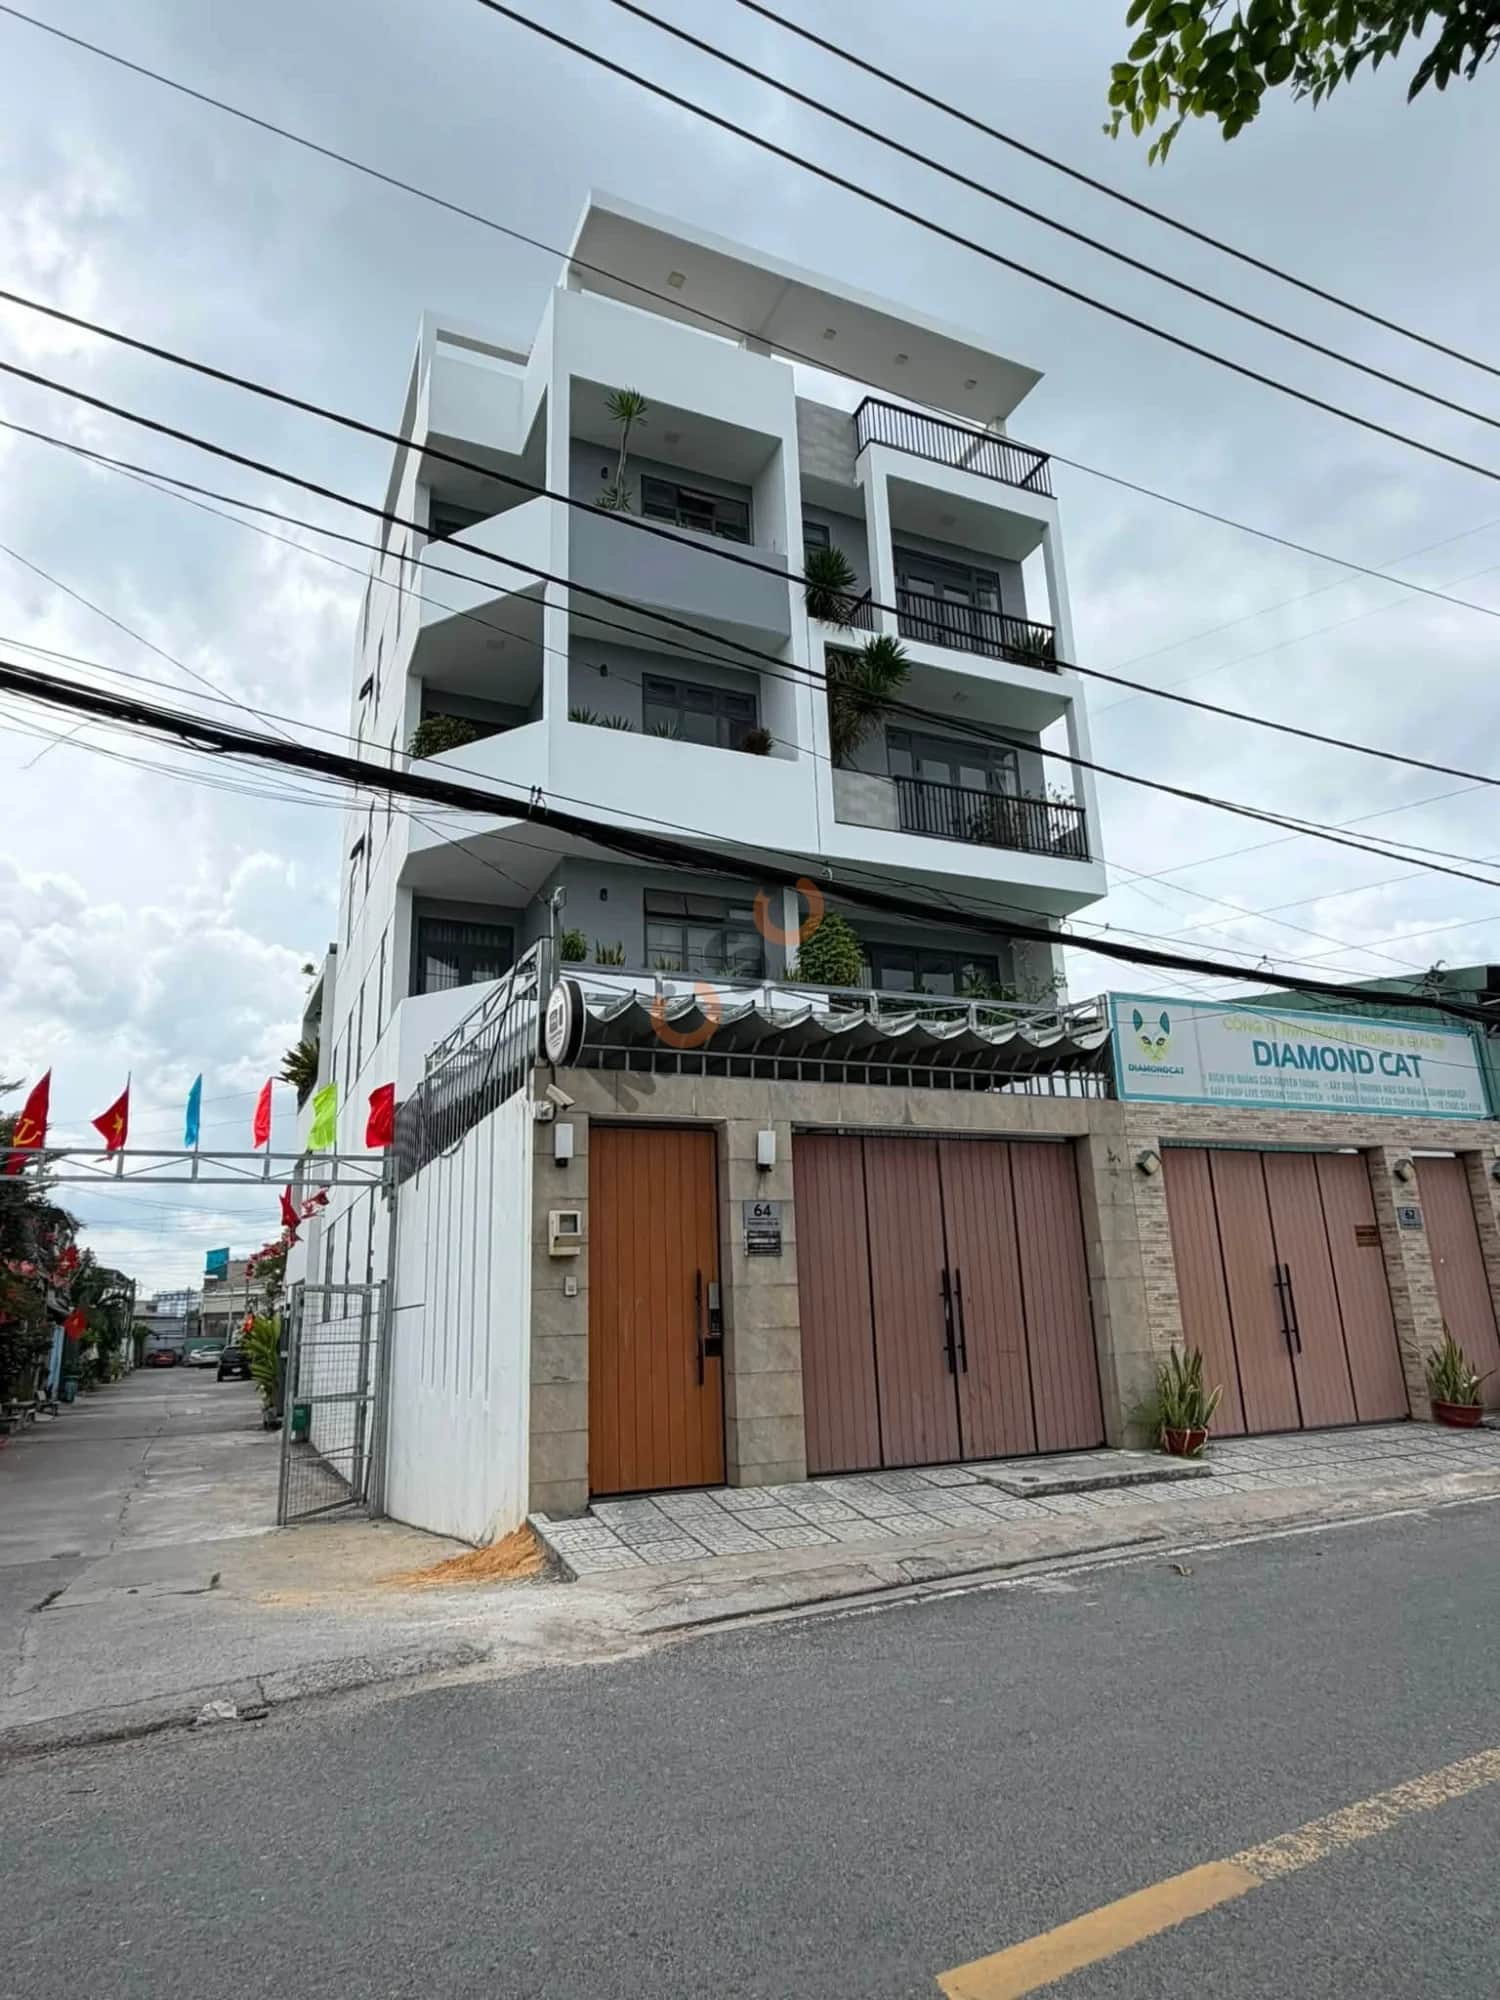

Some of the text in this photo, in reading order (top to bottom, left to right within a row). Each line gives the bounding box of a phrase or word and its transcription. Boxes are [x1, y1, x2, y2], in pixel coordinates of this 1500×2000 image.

[1252, 1040, 1374, 1074] DIAMOND
[1378, 1051, 1423, 1078] CAT
[754, 1203, 771, 1217] 64
